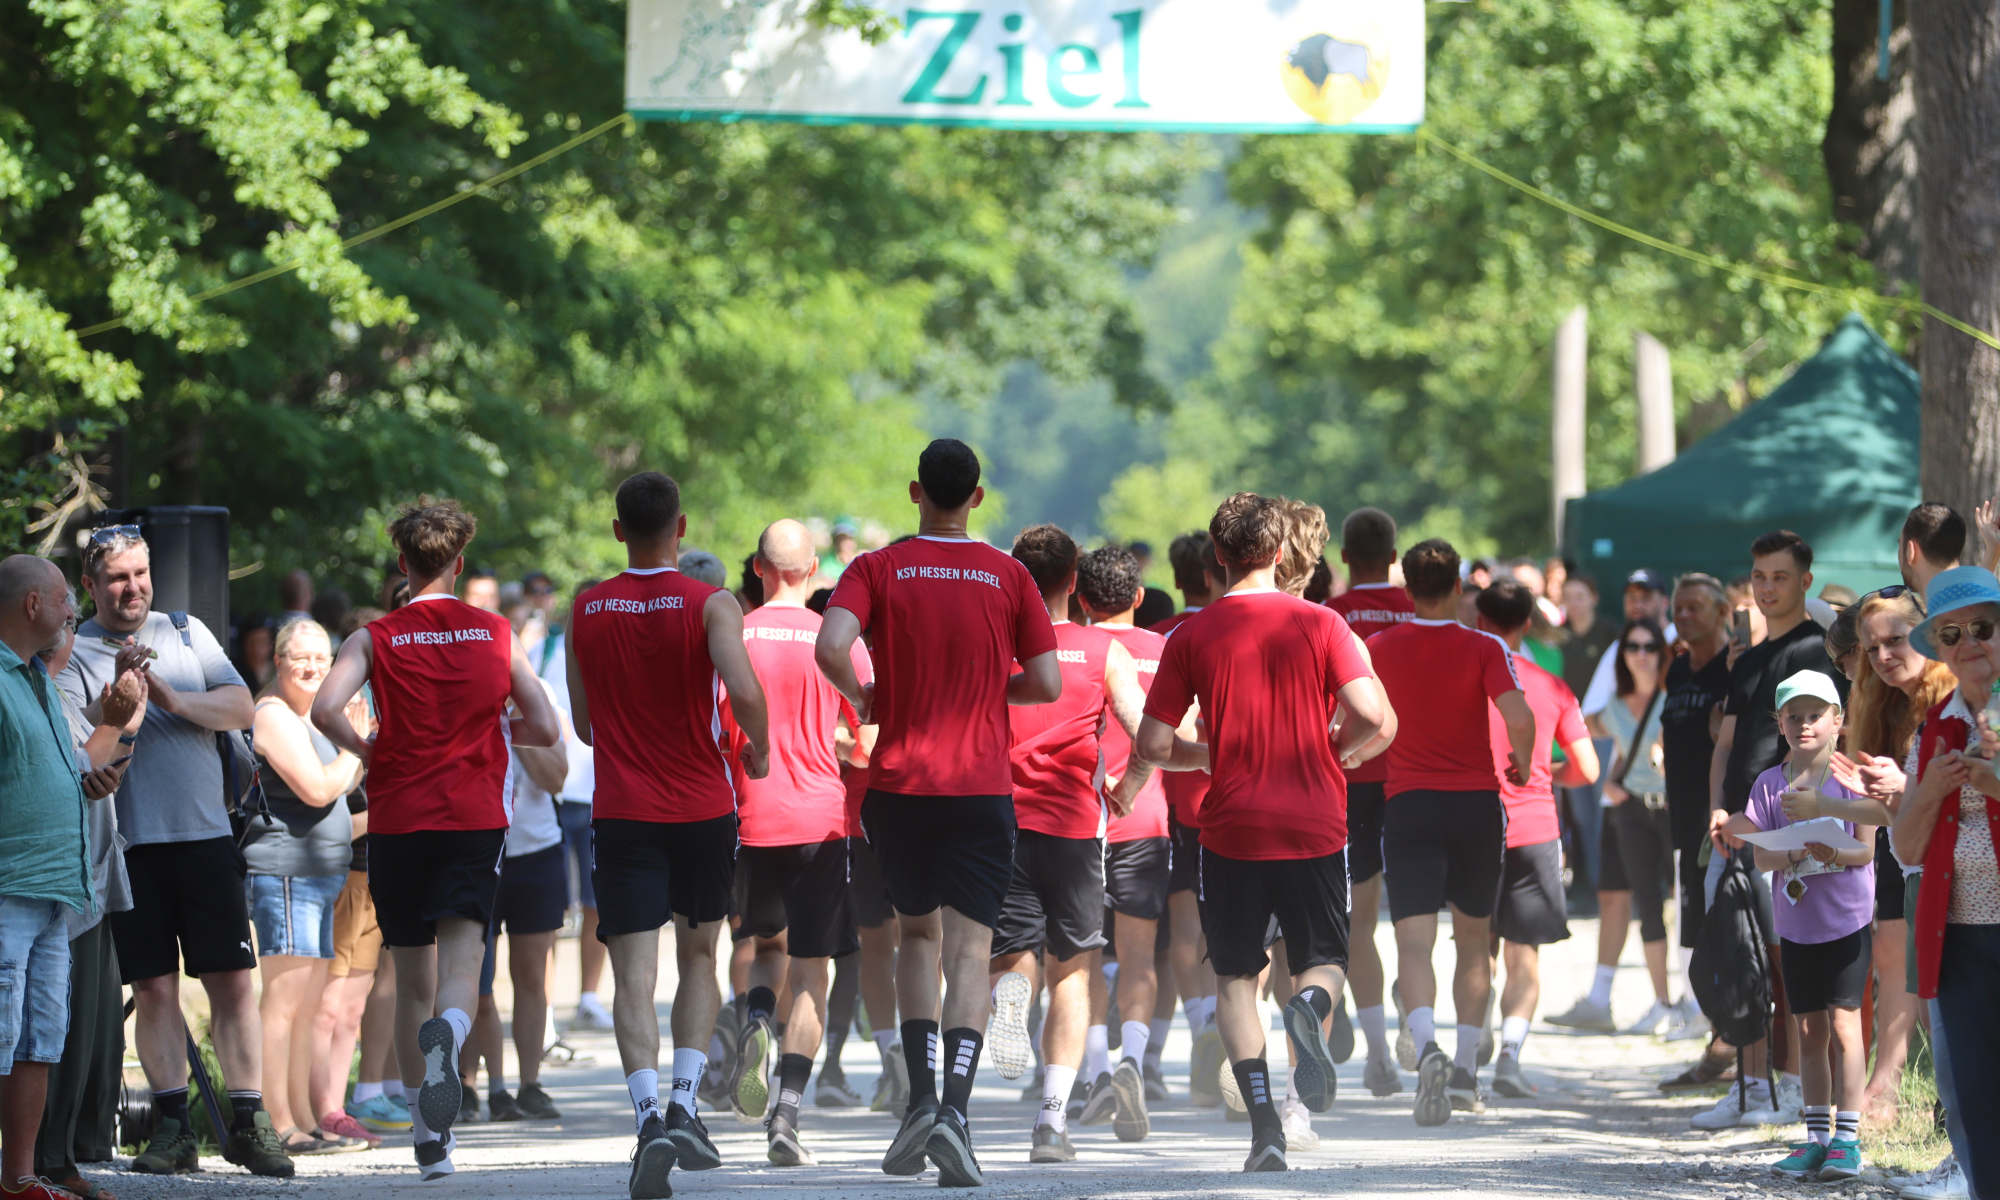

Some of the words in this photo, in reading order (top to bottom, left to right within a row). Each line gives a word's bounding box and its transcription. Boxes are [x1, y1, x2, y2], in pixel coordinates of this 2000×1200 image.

[902, 8, 1151, 108] Ziel
[896, 566, 917, 581] KSV
[919, 566, 960, 580] HESSEN
[963, 568, 1001, 589] KASSEL
[585, 599, 604, 616] KSV
[604, 598, 647, 614] HESSEN
[647, 596, 684, 613] KASSEL
[1394, 611, 1417, 623] KASS
[391, 633, 411, 647] KSV
[413, 630, 454, 645] HESSEN
[455, 628, 494, 642] KASSEL
[743, 627, 756, 641] SV
[756, 627, 794, 641] HESSEN
[794, 629, 819, 645] KASS
[1056, 650, 1088, 663] ASSEL
[1042, 1098, 1062, 1111] FS
